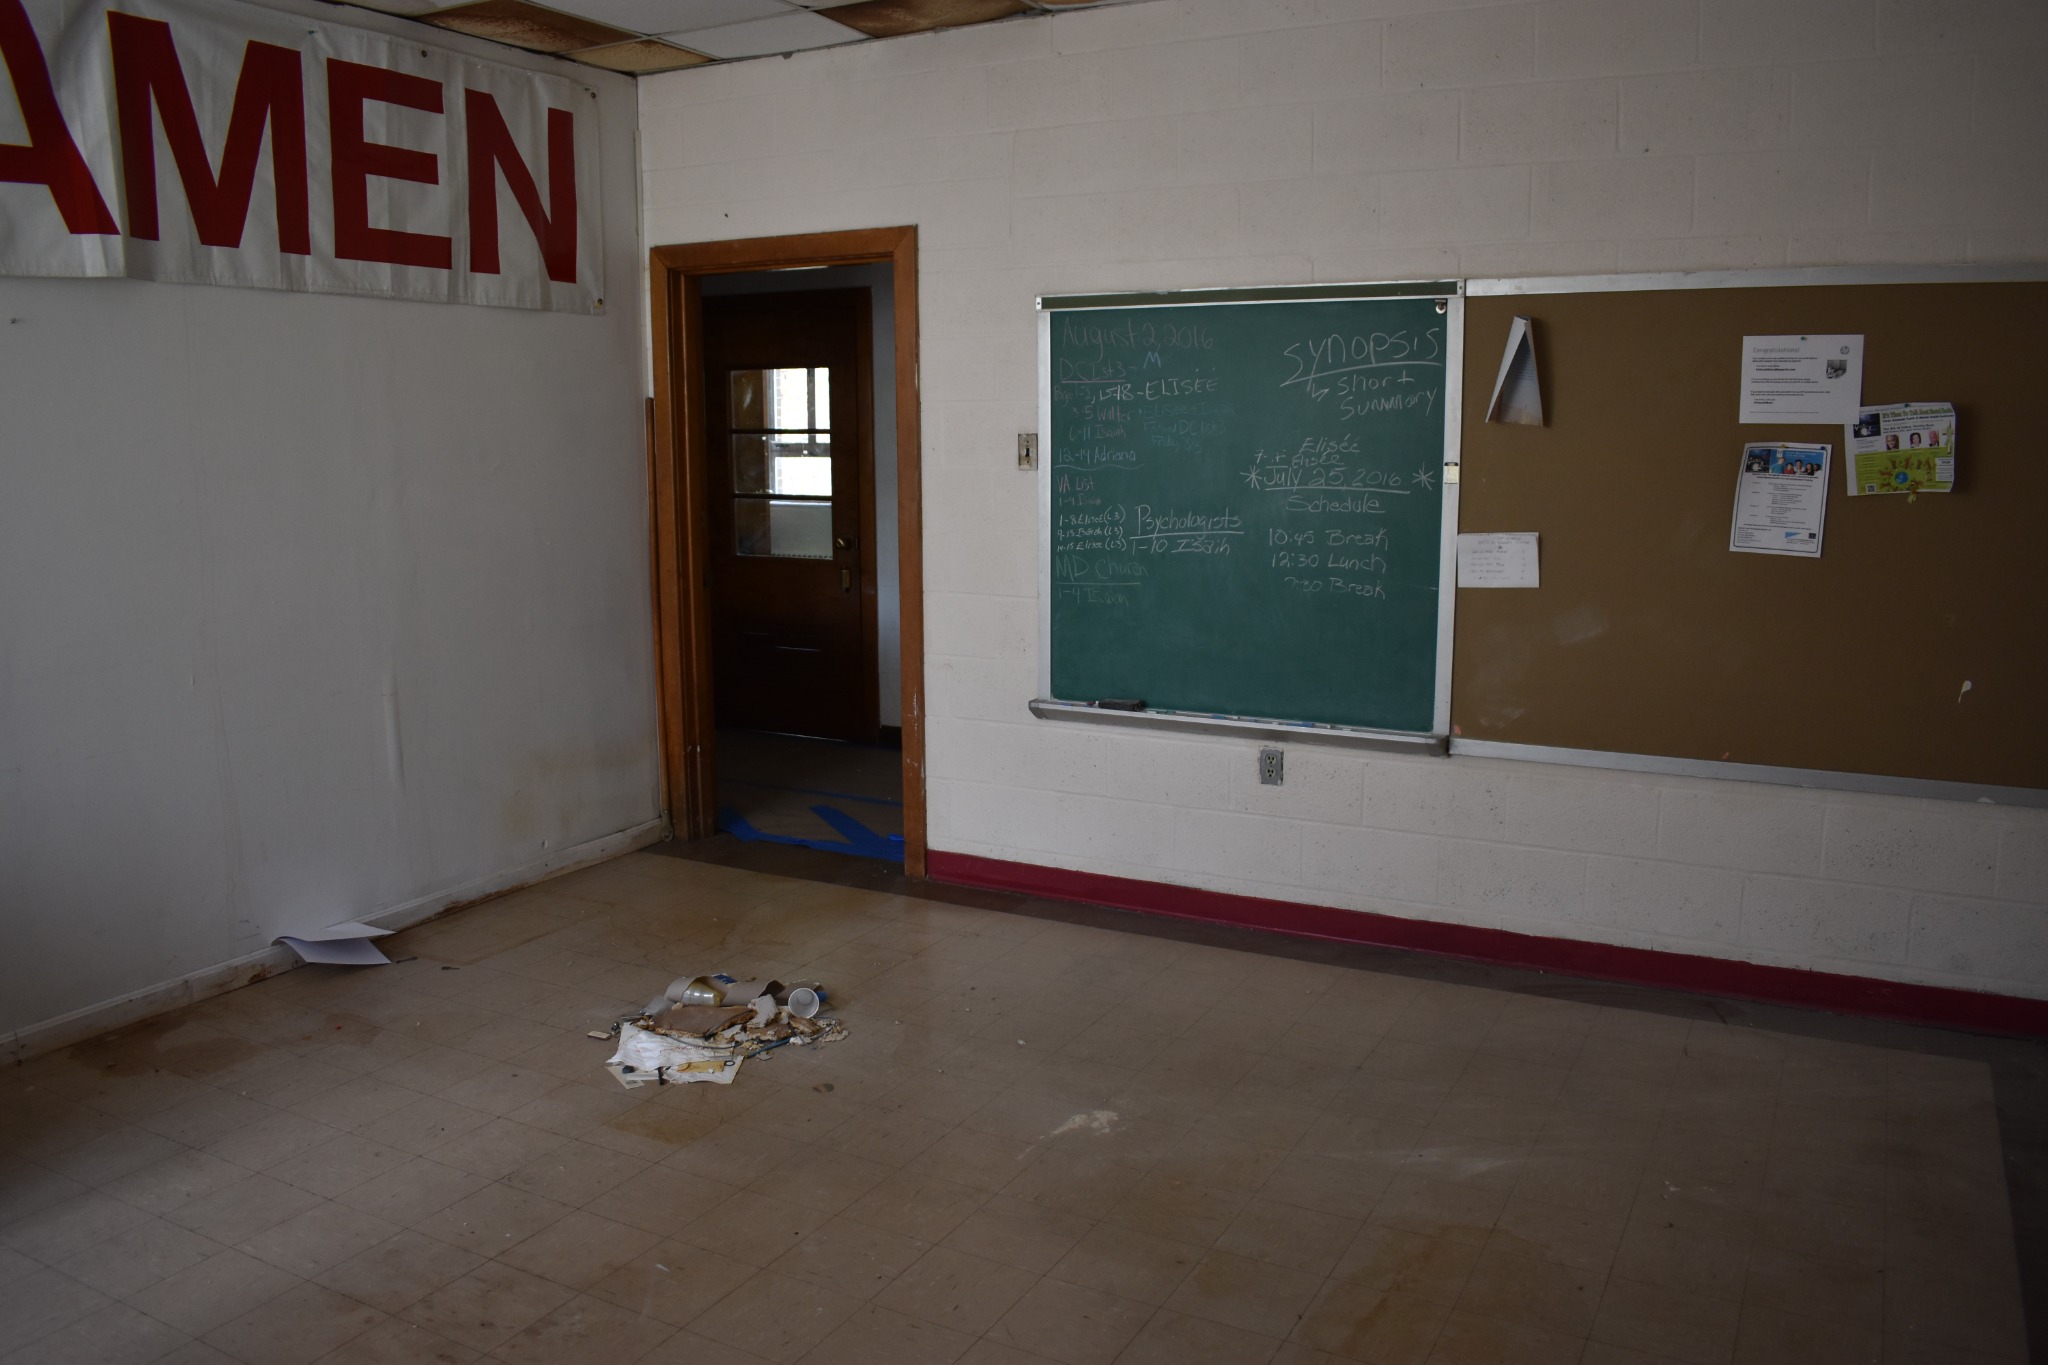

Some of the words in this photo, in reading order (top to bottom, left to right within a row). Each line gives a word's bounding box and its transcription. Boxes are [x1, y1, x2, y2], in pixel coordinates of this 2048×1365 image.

[1352, 468, 1402, 487] 2016
[1285, 493, 1386, 514] Schedule
[1134, 503, 1243, 540] Psychologists
[1272, 551, 1320, 569] 12:30
[1327, 552, 1387, 574] Lunch
[1329, 577, 1386, 600] Break
